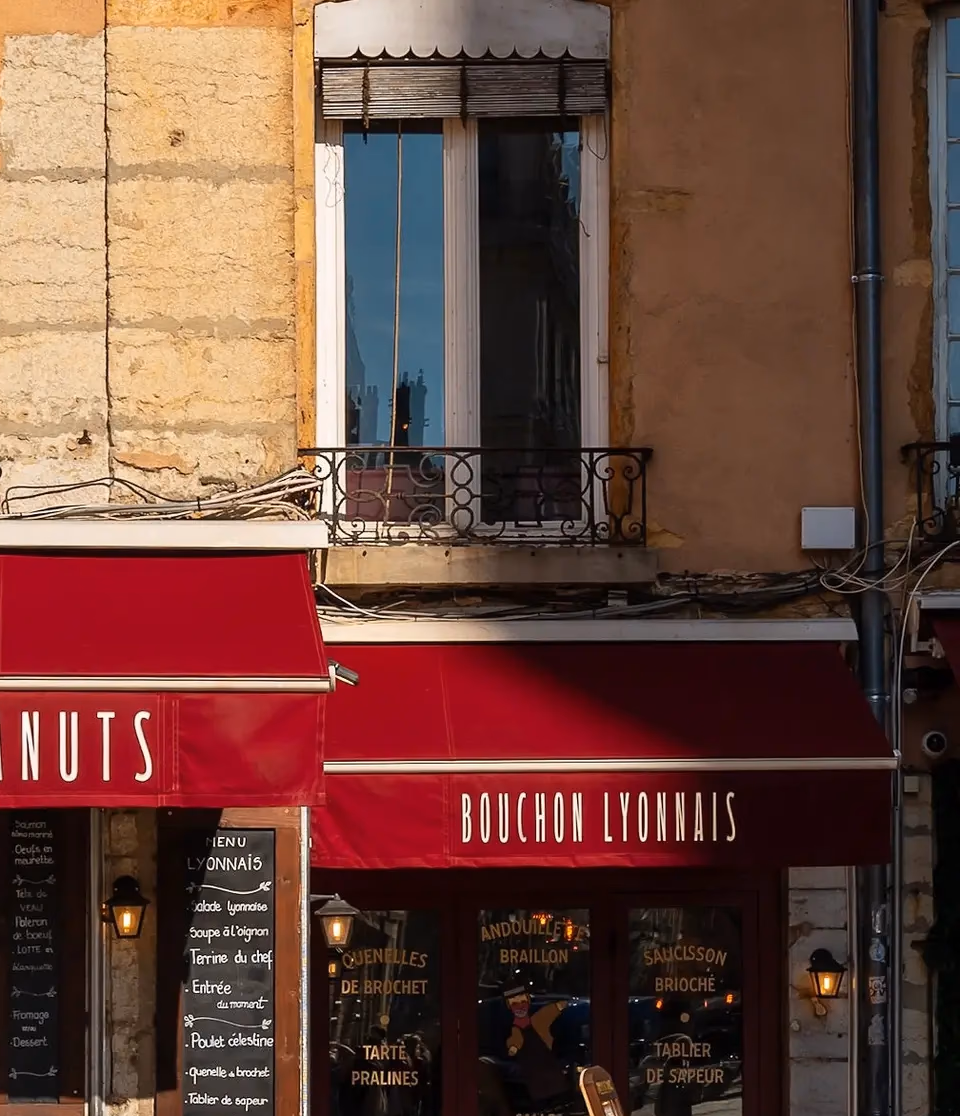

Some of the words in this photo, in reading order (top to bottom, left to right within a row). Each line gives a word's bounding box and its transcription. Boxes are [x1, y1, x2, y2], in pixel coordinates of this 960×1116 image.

[461, 791, 583, 843] BOUCHON
[603, 791, 737, 843] LYONNAIS
[206, 836, 247, 848] MENU
[192, 900, 222, 912] Salade
[227, 900, 268, 916] lyonnaise
[190, 926, 221, 944] Soupe
[190, 948, 229, 965] Terrine
[234, 949, 247, 964] du
[250, 949, 273, 970] chef
[341, 947, 429, 970] QUENELLES
[499, 947, 569, 965] BRAILLON
[643, 945, 728, 967] SAUCISSON
[192, 979, 232, 995] Entrée
[341, 979, 360, 996] DE
[363, 979, 428, 996] BROCHET
[654, 974, 716, 993] BRIOCHÉ
[216, 999, 230, 1010] du
[230, 997, 269, 1010] moment
[12, 1010, 50, 1026] Fromage
[12, 1036, 49, 1048] Dessert
[191, 1032, 226, 1049] Poulet
[228, 1032, 274, 1048] célestine
[362, 1044, 408, 1062] TARTE
[654, 1042, 712, 1058] TABLIER
[235, 1066, 270, 1078] brochet
[351, 1070, 419, 1087] PRALINES
[646, 1068, 665, 1085] DE
[667, 1068, 724, 1085] SAPEUR
[188, 1091, 220, 1106] Tablier
[221, 1094, 233, 1106] de
[235, 1097, 270, 1111] sapeur
